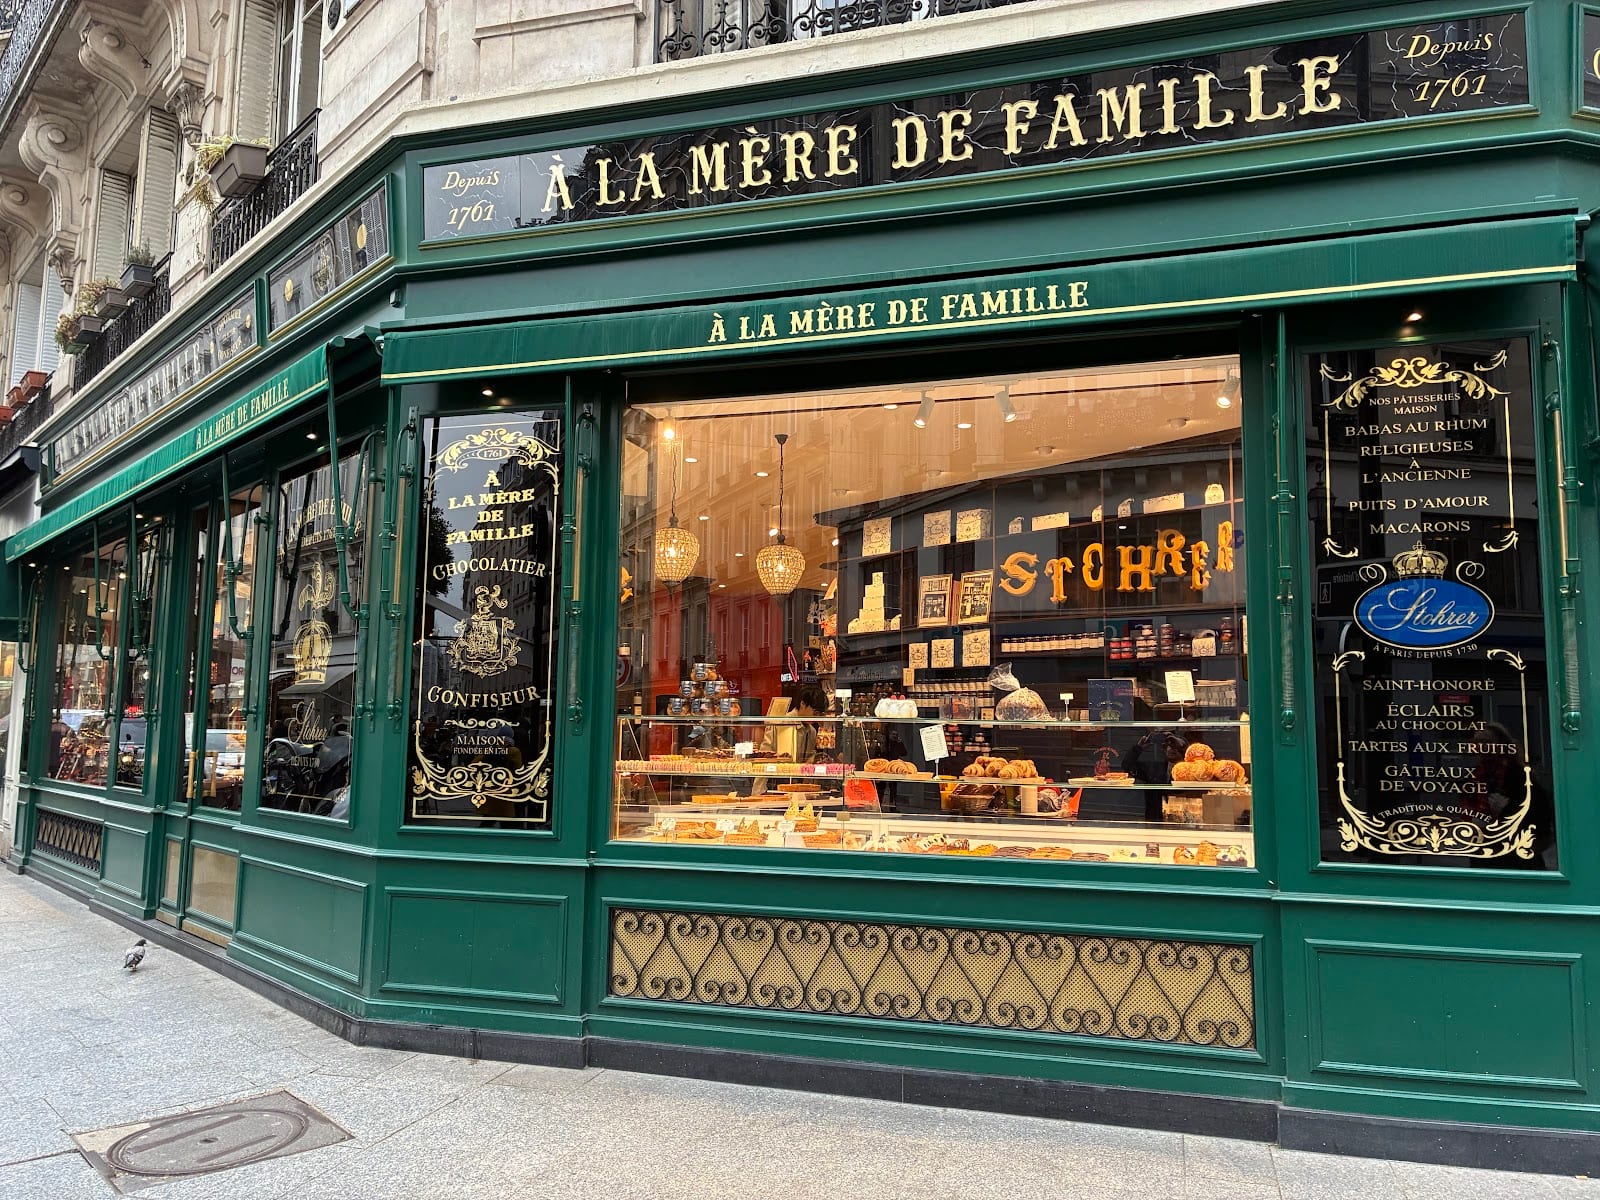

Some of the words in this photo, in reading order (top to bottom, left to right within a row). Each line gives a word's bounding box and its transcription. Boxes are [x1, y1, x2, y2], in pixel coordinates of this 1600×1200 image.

[1403, 33, 1494, 69] Depuis
[1413, 69, 1487, 109] 1761
[540, 153, 574, 213] À
[594, 152, 666, 206] LA
[688, 126, 859, 195] MÈRE
[891, 108, 974, 170] DE
[1000, 54, 1342, 156] FAMILLE
[441, 170, 501, 197] Depuis
[446, 200, 495, 230] 1761
[708, 312, 727, 343] À
[738, 313, 778, 341] LA
[789, 301, 876, 336] MÈRE
[887, 297, 929, 325] DE
[940, 281, 1090, 320] FAMILLE
[1369, 398, 1390, 406] NOS
[1394, 393, 1461, 405] PÂTISSERIES
[196, 428, 202, 450] À
[203, 425, 213, 446] LA
[214, 413, 235, 439] MÈRE
[237, 403, 248, 425] DE
[250, 378, 289, 418] FAMILLE
[1394, 405, 1437, 415] MAISON
[1345, 424, 1401, 436] BABAS
[1405, 422, 1429, 434] AU
[1434, 418, 1488, 431] RHUM
[482, 450, 503, 458] 1761
[1361, 440, 1474, 456] RELIGIEUSES
[1409, 457, 1420, 469] À
[483, 470, 501, 488] À
[1363, 469, 1472, 484] L'ANCIENNE
[448, 494, 476, 510] LA
[479, 488, 535, 506] MÈRE
[1349, 499, 1396, 512] PUITS
[1404, 495, 1490, 510] D'AMOUR
[477, 509, 504, 523] DE
[446, 523, 534, 546] FAMILLE
[1370, 520, 1470, 534] MACARONS
[432, 557, 546, 580] CHOCOLATIER
[1368, 587, 1479, 632] Stohrer
[1373, 642, 1380, 652] À
[1383, 647, 1413, 659] PARIS
[1416, 649, 1453, 659] DEPUIS
[1456, 643, 1478, 656] 1730
[1363, 677, 1496, 691] SAINT-HONORÉ
[427, 685, 541, 708] CONFISEUR
[1387, 702, 1475, 717] ÉCLAIRS
[1375, 720, 1397, 730] AU
[1401, 720, 1487, 731] CHOCOLAT
[457, 735, 506, 746] MAISON
[1349, 741, 1408, 752] TARTES
[1413, 742, 1450, 754] AUX
[1457, 743, 1517, 755] FRUITS
[453, 746, 483, 755] FONDÉE
[484, 746, 494, 755] EN
[494, 747, 509, 755] 1761
[1384, 763, 1477, 779] GÂTEAUX
[1380, 780, 1405, 792] DE
[1408, 780, 1489, 794] VOYAGE
[1378, 804, 1434, 819] TRADITION
[1446, 805, 1493, 823] QUALITÉ
